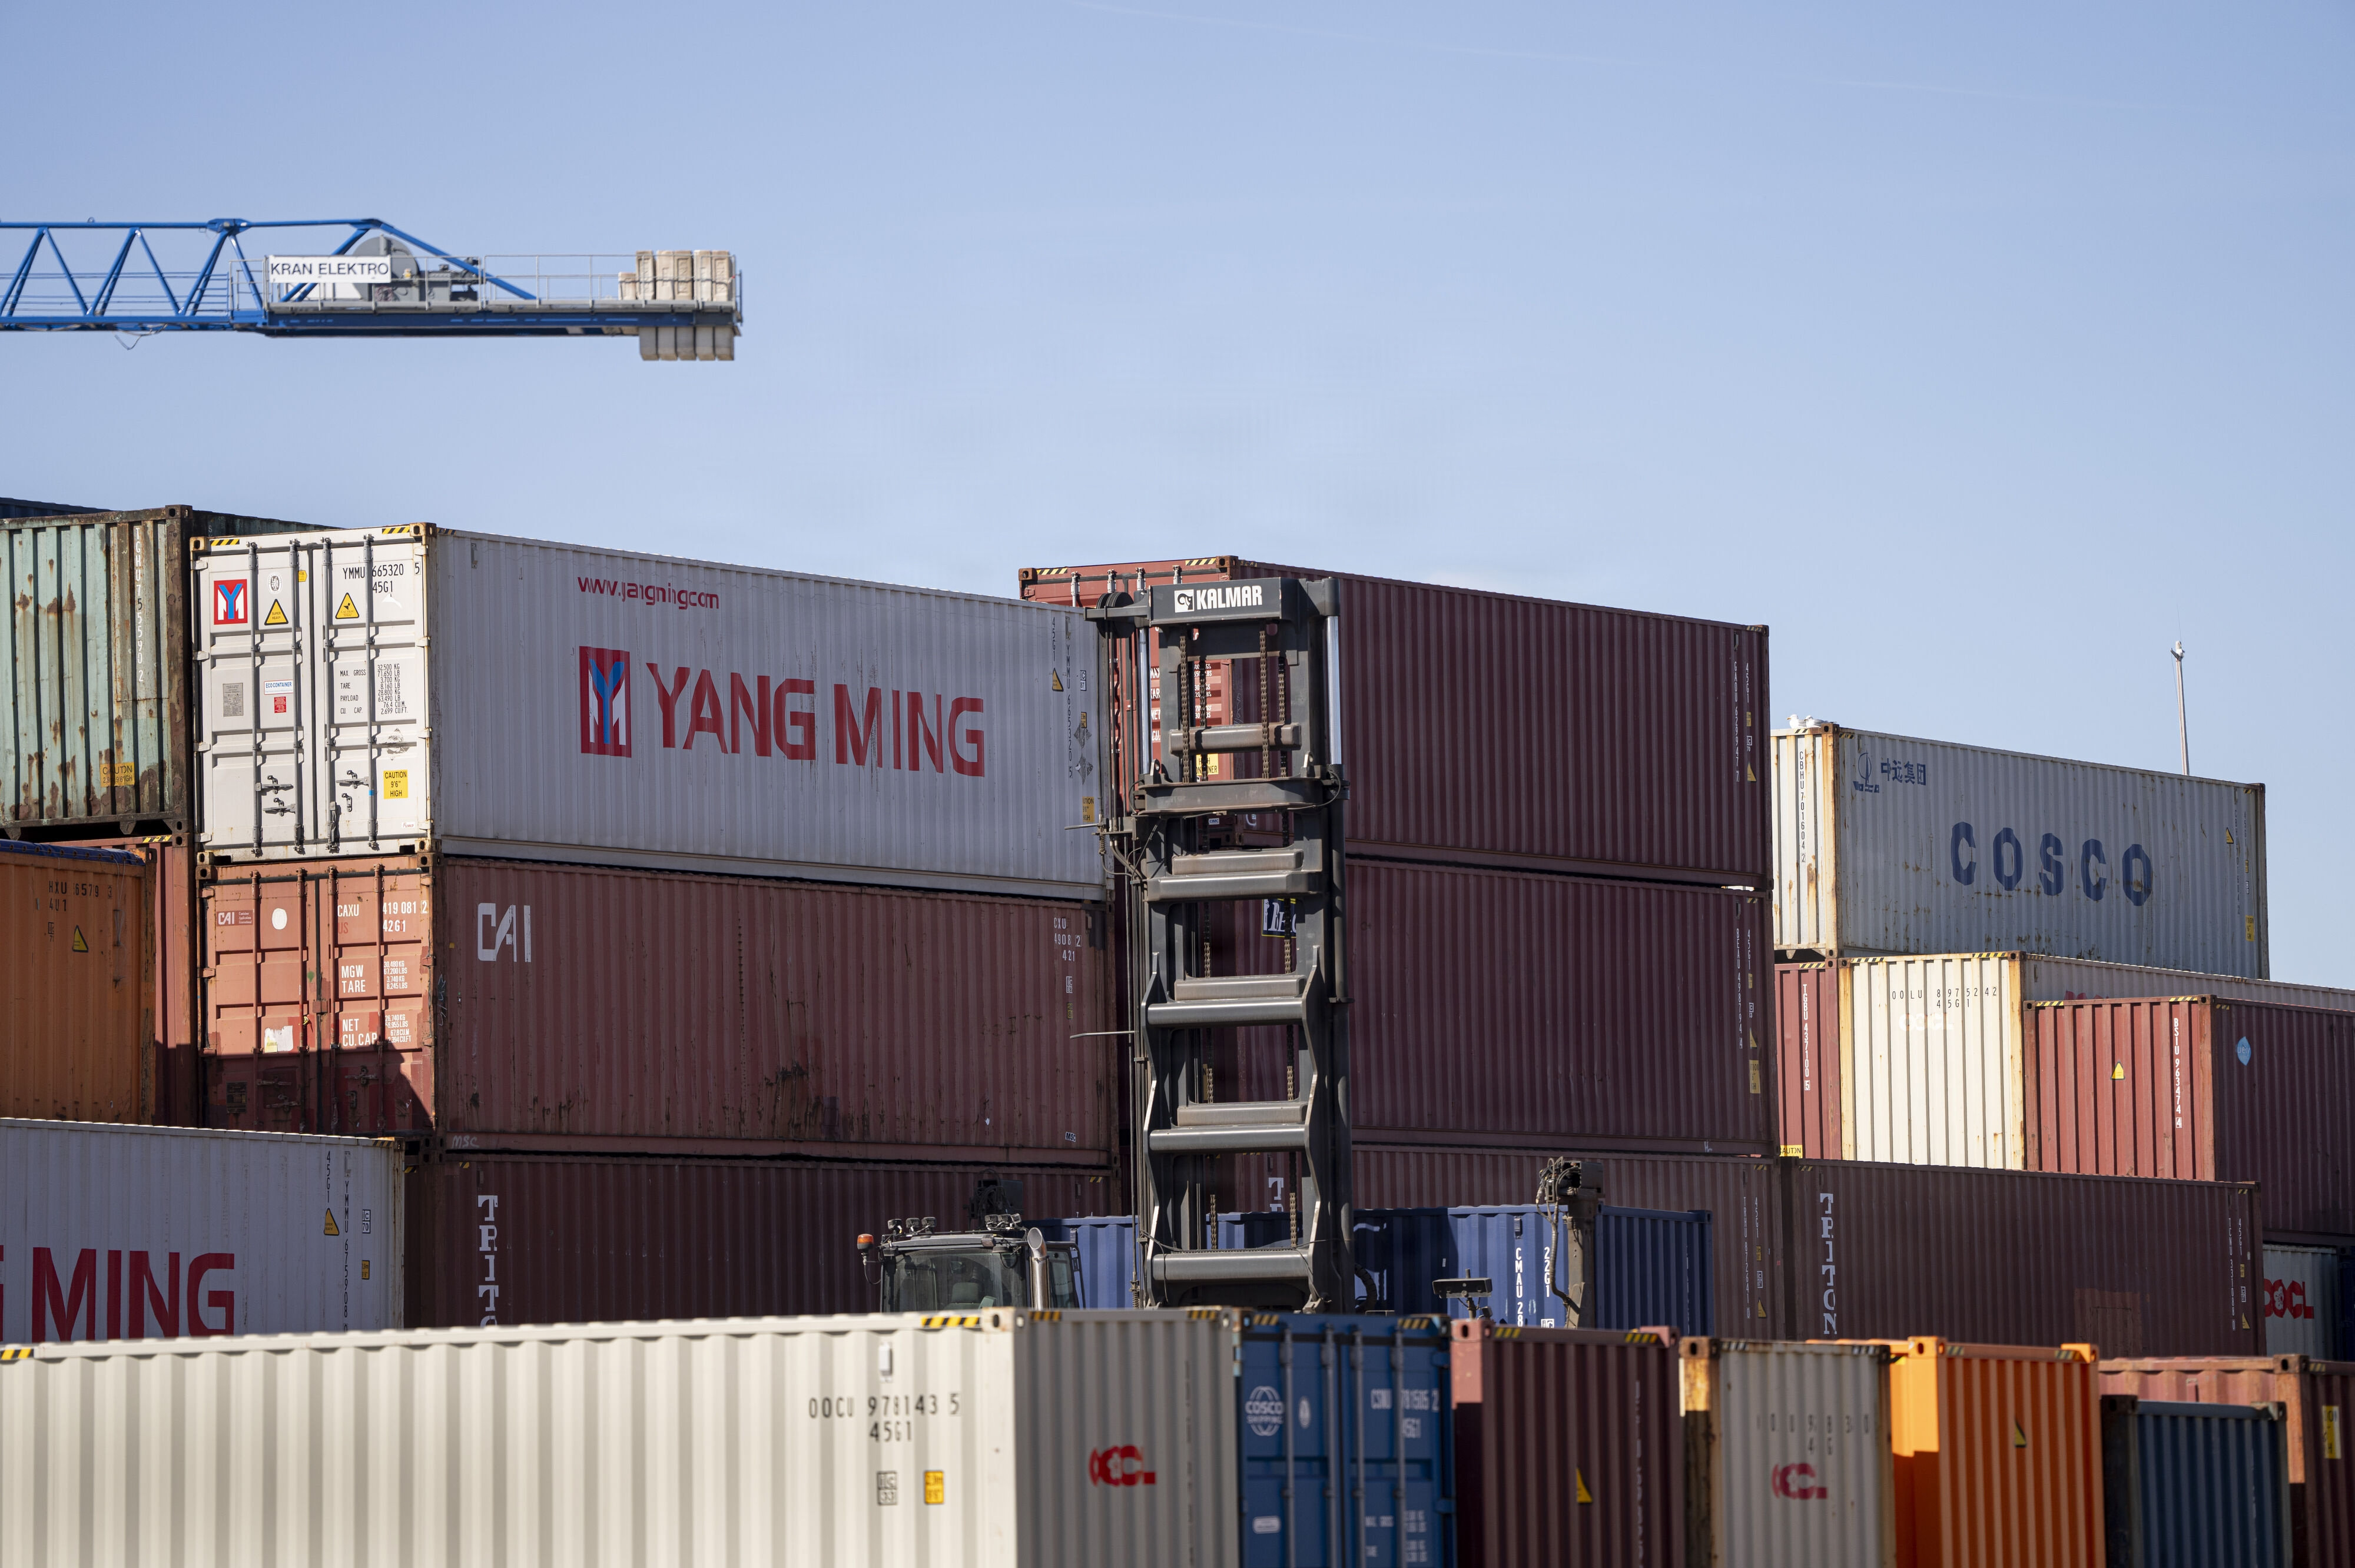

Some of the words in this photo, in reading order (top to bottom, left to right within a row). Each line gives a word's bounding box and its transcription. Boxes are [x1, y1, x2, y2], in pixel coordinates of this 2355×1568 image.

[271, 263, 312, 275] KRAN
[319, 263, 389, 275] ELEKTRO
[343, 566, 365, 580] YMMU
[372, 563, 404, 577] 665320
[414, 562, 420, 574] 5
[372, 580, 393, 593] 45G1
[1197, 585, 1262, 610] KALMAR
[646, 662, 816, 760] YANG
[833, 683, 986, 778] MING
[384, 771, 407, 779] CAUTION
[1951, 822, 2152, 906] COSCO
[337, 903, 360, 917] CAXU
[383, 902, 398, 915] 419
[401, 901, 416, 914] 081
[422, 901, 427, 913] 2
[218, 912, 235, 925] CAI
[478, 902, 532, 963] CAI
[341, 965, 364, 978] MGW
[341, 979, 366, 993] TARE
[1936, 998, 1969, 1008] 45G1
[342, 1018, 360, 1032] NET
[452, 1135, 480, 1148] MSC
[1820, 1192, 1837, 1334] TRITON
[1515, 1247, 1523, 1298] CMAU
[32, 1247, 235, 1342] MING
[867, 1394, 938, 1417] 978143
[949, 1393, 960, 1416] 5
[1245, 1401, 1285, 1414] COSCO
[1246, 1415, 1284, 1424] SHIPPING
[868, 1421, 912, 1442] 45G1
